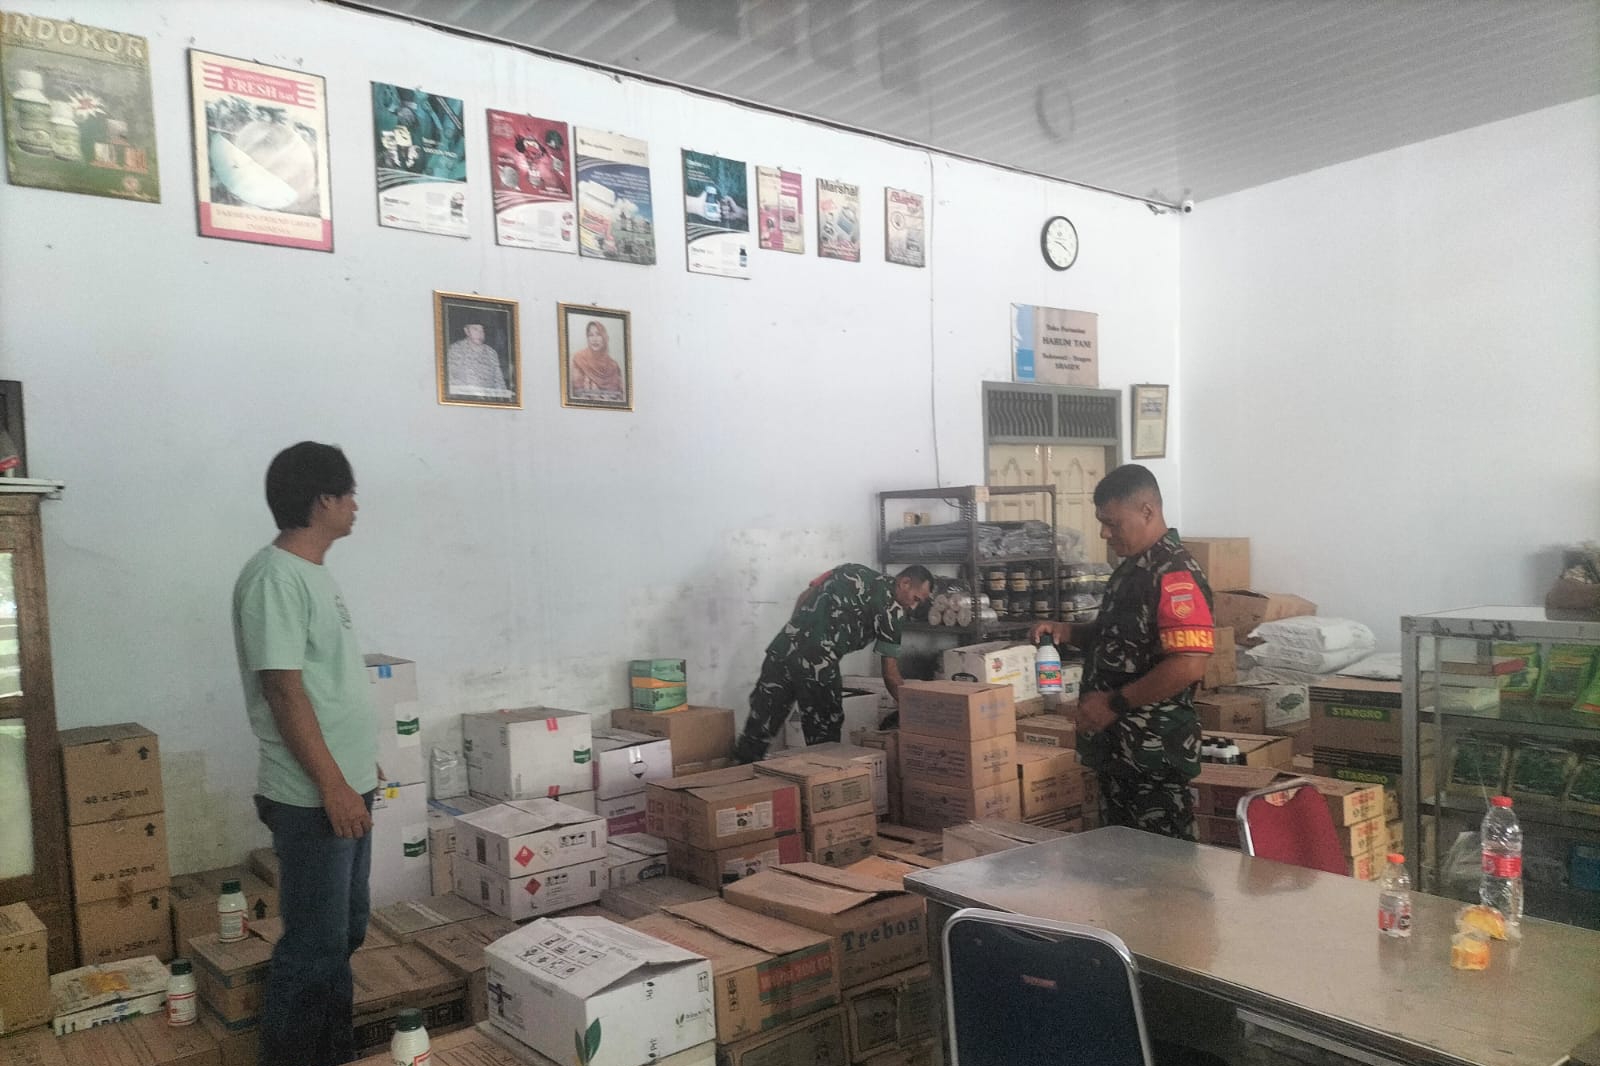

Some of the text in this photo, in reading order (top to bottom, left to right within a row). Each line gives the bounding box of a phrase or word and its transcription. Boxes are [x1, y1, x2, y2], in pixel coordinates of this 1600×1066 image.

[1, 13, 144, 58] INDOKOR
[227, 77, 278, 99] FRESH
[1331, 706, 1383, 719] STARGRO
[841, 917, 920, 952] Trebon
